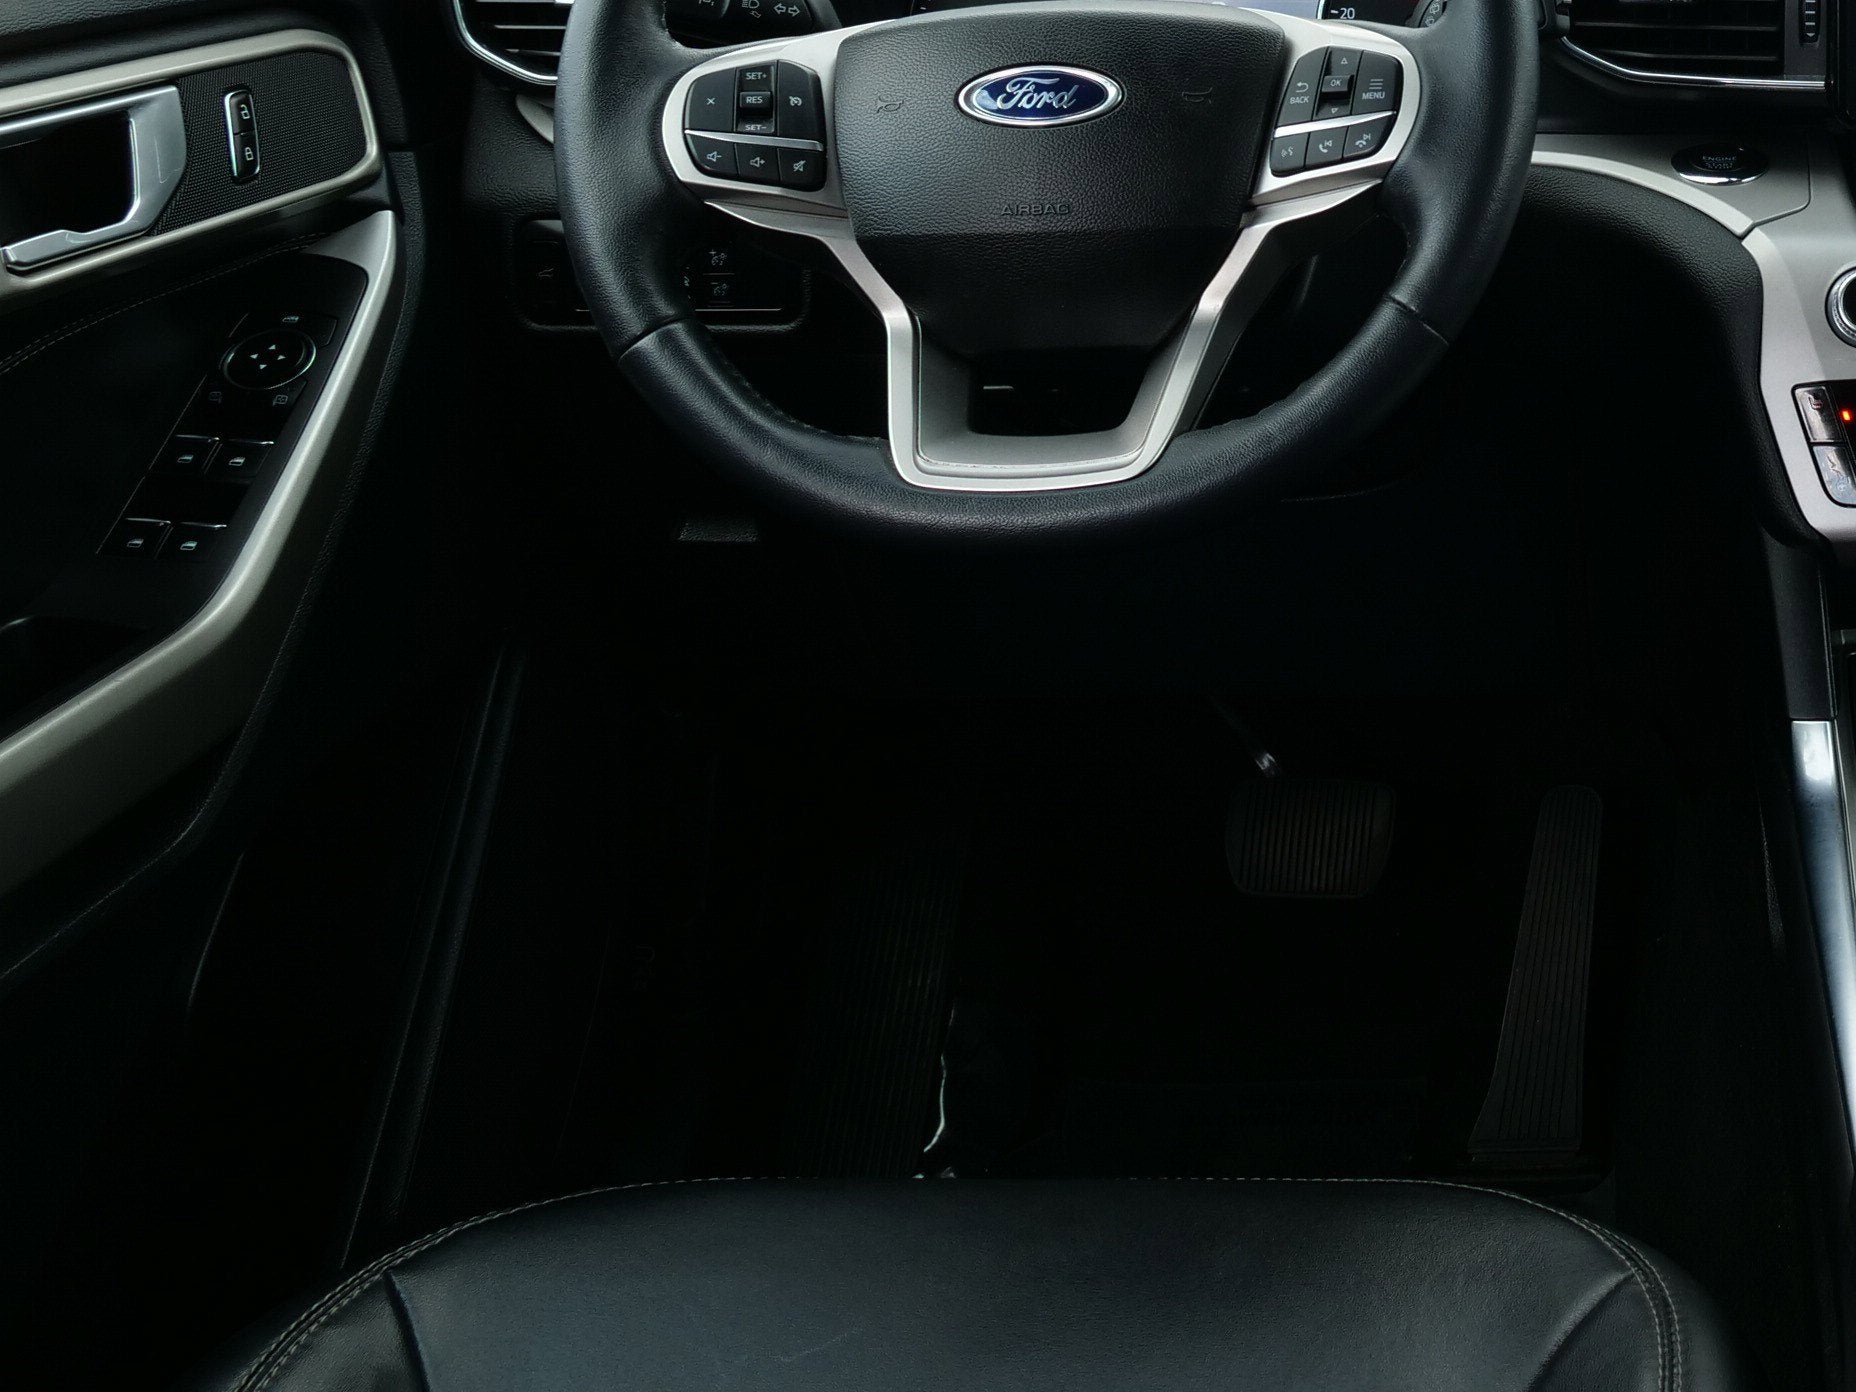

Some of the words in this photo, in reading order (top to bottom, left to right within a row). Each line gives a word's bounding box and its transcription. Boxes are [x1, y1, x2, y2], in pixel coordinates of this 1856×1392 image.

[1340, 8, 1355, 19] 20
[745, 71, 767, 80] SET+
[1330, 79, 1341, 87] OK
[996, 77, 1080, 109] Ford
[1362, 91, 1386, 101] MENU
[746, 96, 764, 104] RES
[1289, 95, 1310, 104] BACK
[1000, 204, 1072, 216] AIRBAG
